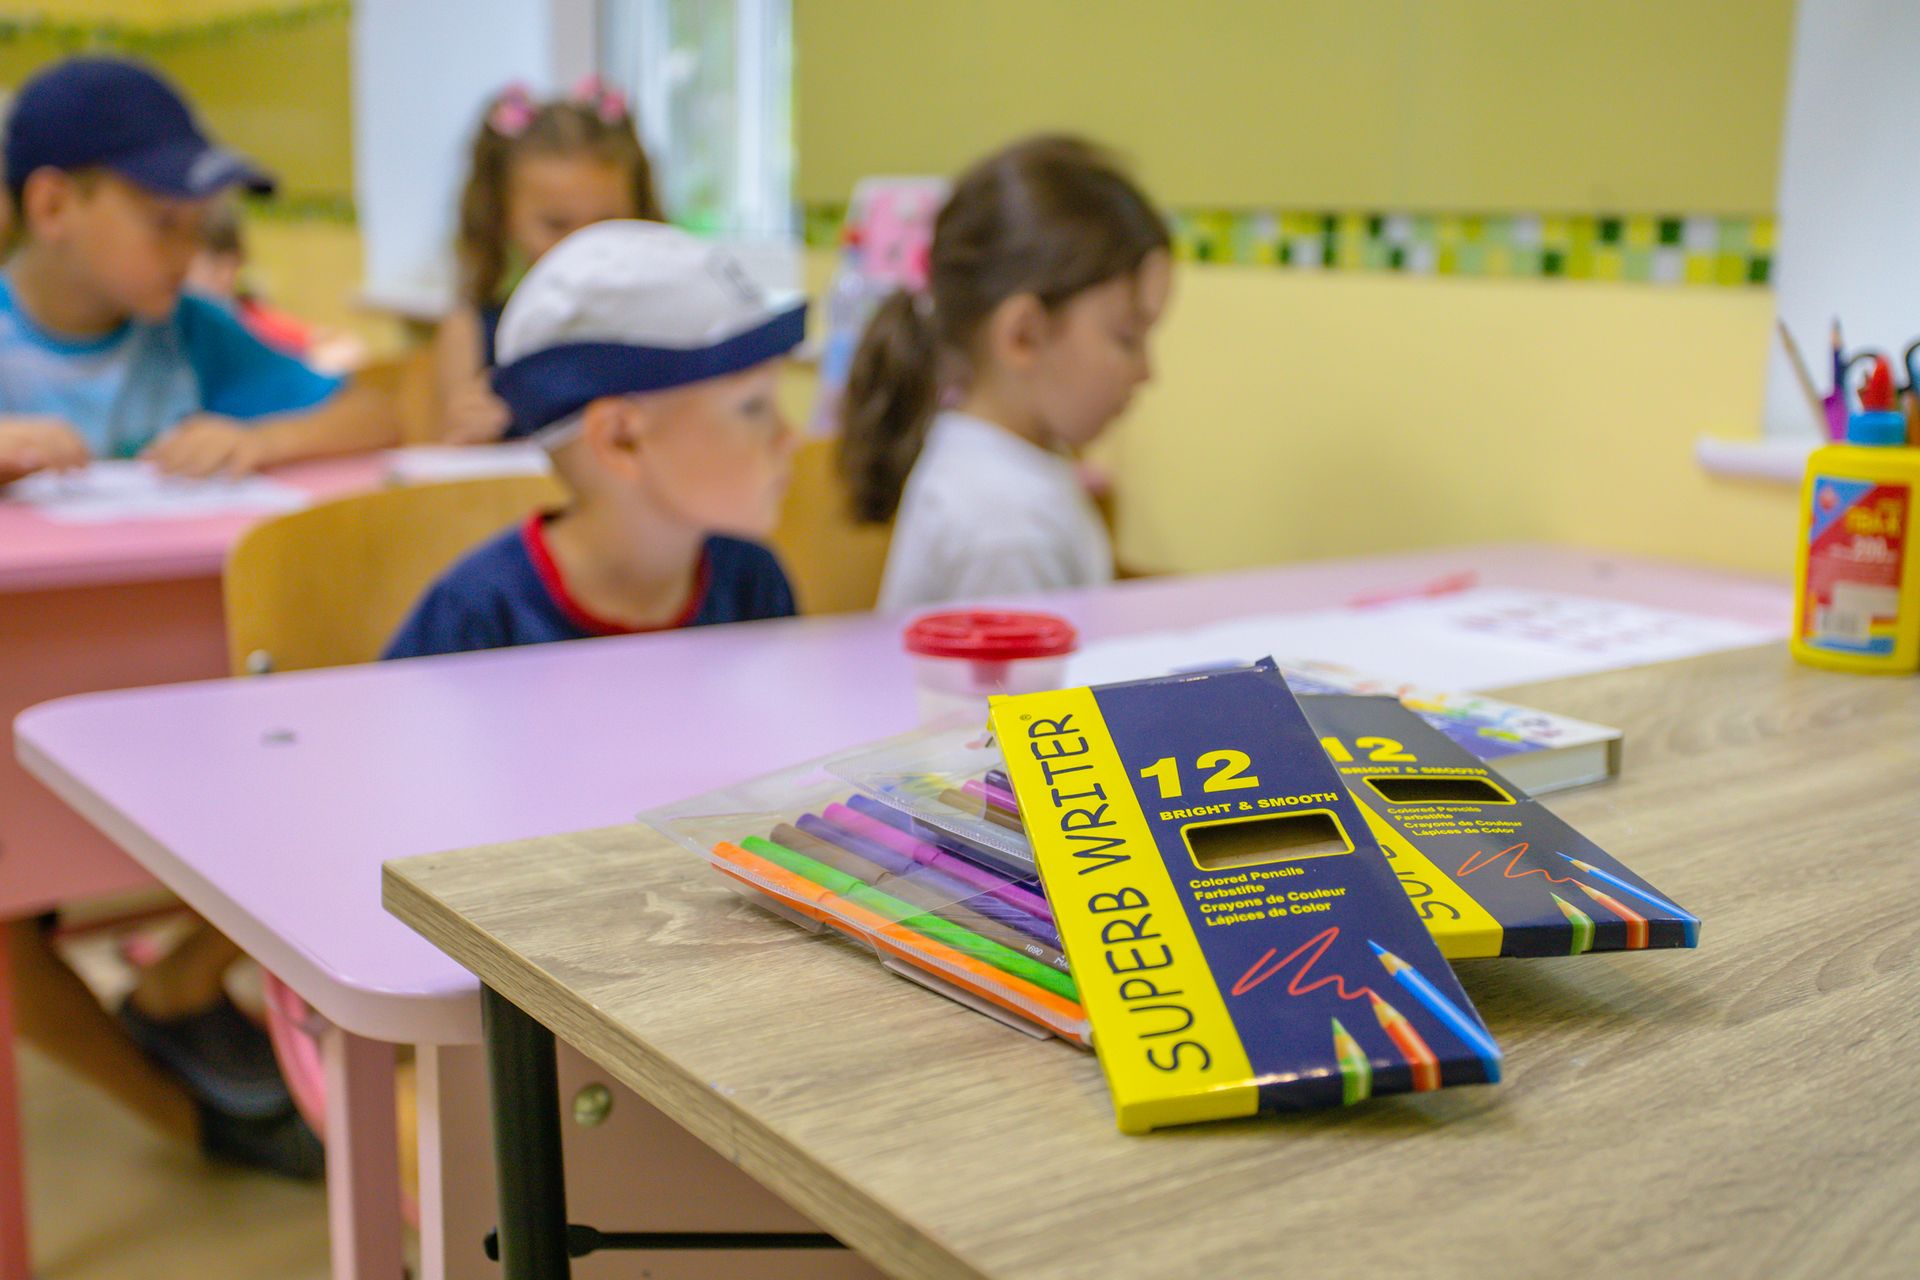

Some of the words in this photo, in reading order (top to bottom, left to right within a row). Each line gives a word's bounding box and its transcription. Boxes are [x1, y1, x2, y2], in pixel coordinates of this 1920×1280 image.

[1320, 736, 1418, 763] 12
[1140, 749, 1260, 799] 12
[1338, 766, 1400, 775] BRIGHT
[1405, 766, 1418, 774] &
[1420, 767, 1488, 775] SMOOTH
[1028, 713, 1132, 875] WRITER
[1159, 803, 1231, 821] BRIGHT
[1238, 801, 1253, 811] &
[1258, 792, 1339, 809] SMOOTH
[1387, 806, 1435, 814] Colored
[1394, 813, 1454, 821] Farbstifte
[1403, 821, 1456, 829] Crayons
[1190, 874, 1248, 889] Colored
[1250, 867, 1304, 881] Pencils
[1194, 884, 1265, 901] Farbstifte
[1200, 898, 1263, 913] Crayons
[1265, 895, 1285, 904] de
[1287, 887, 1346, 902] Couleur
[1206, 911, 1266, 926] Lápices
[1268, 907, 1288, 917] de
[1290, 902, 1332, 915] Color
[1088, 887, 1211, 1073] SUPERB
